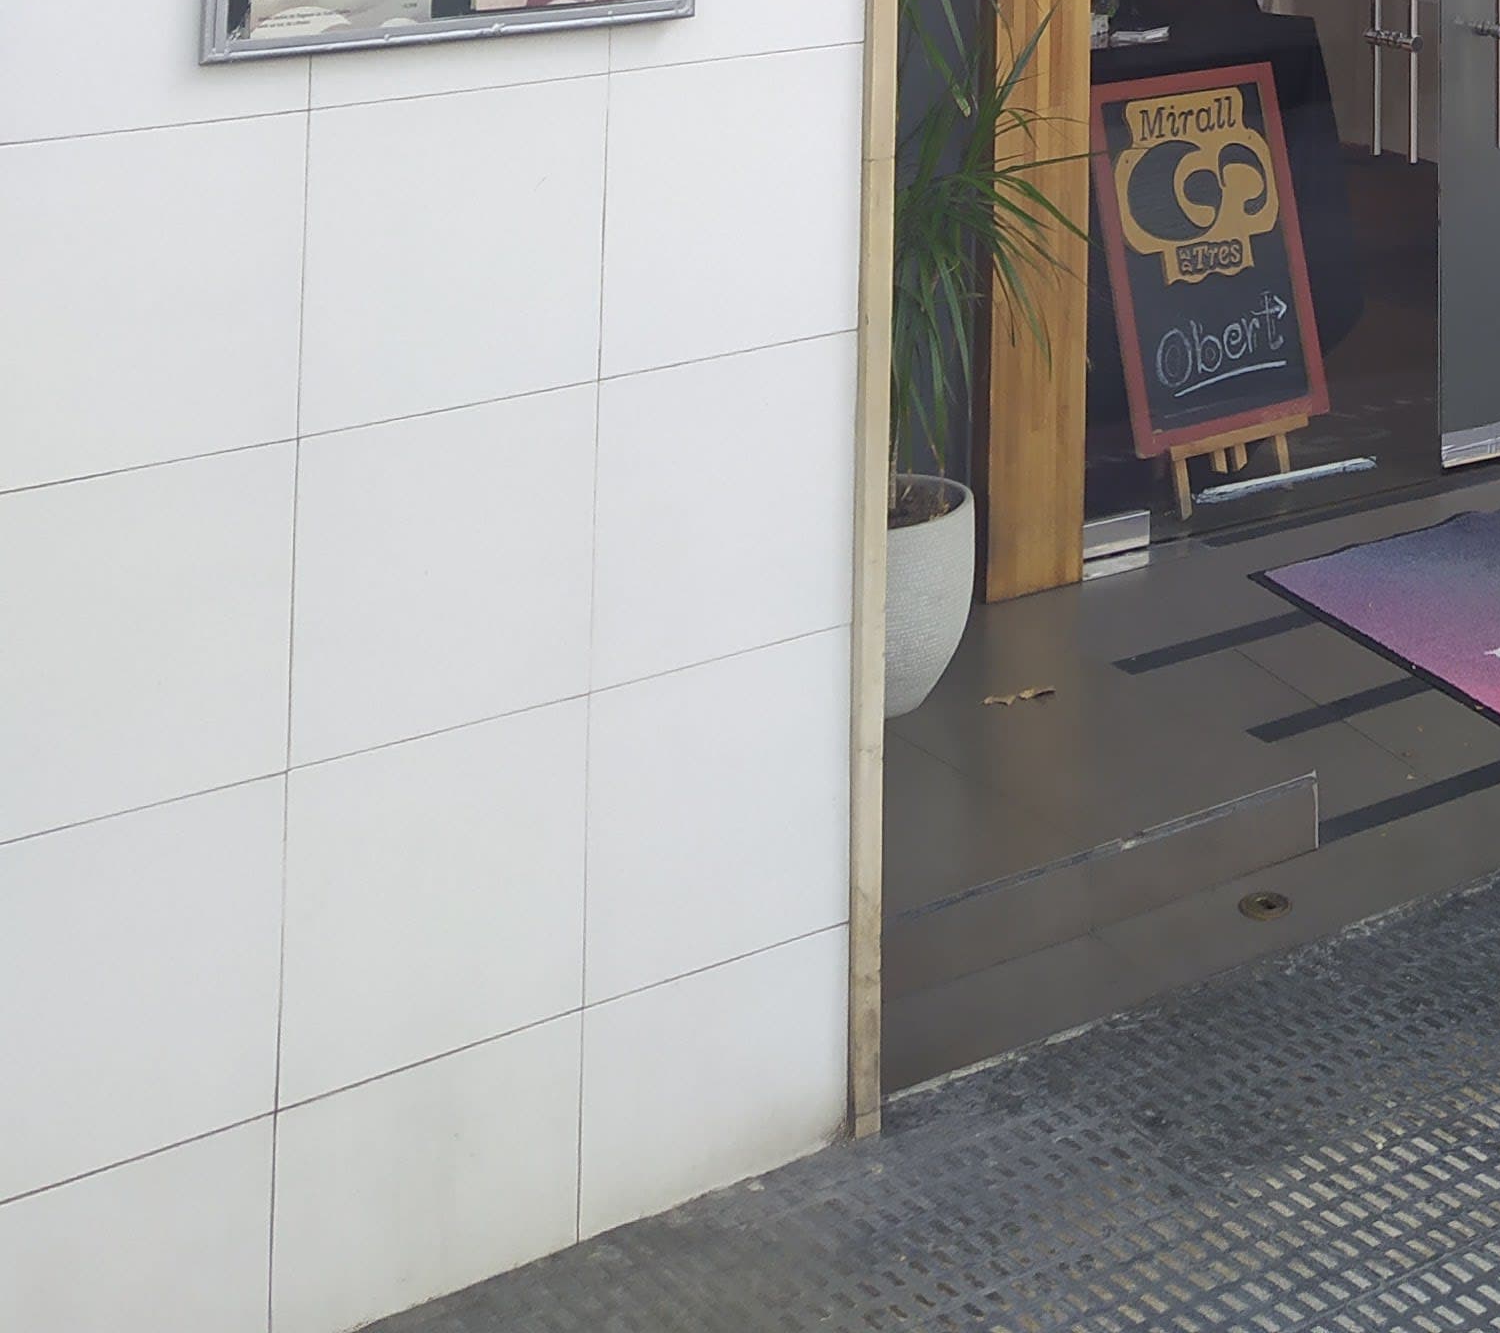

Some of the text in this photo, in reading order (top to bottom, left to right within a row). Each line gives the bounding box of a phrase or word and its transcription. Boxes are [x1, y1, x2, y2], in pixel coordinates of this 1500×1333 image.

[1139, 96, 1236, 142] Mirall
[1192, 242, 1241, 270] Tres
[1155, 291, 1286, 388] Obert
